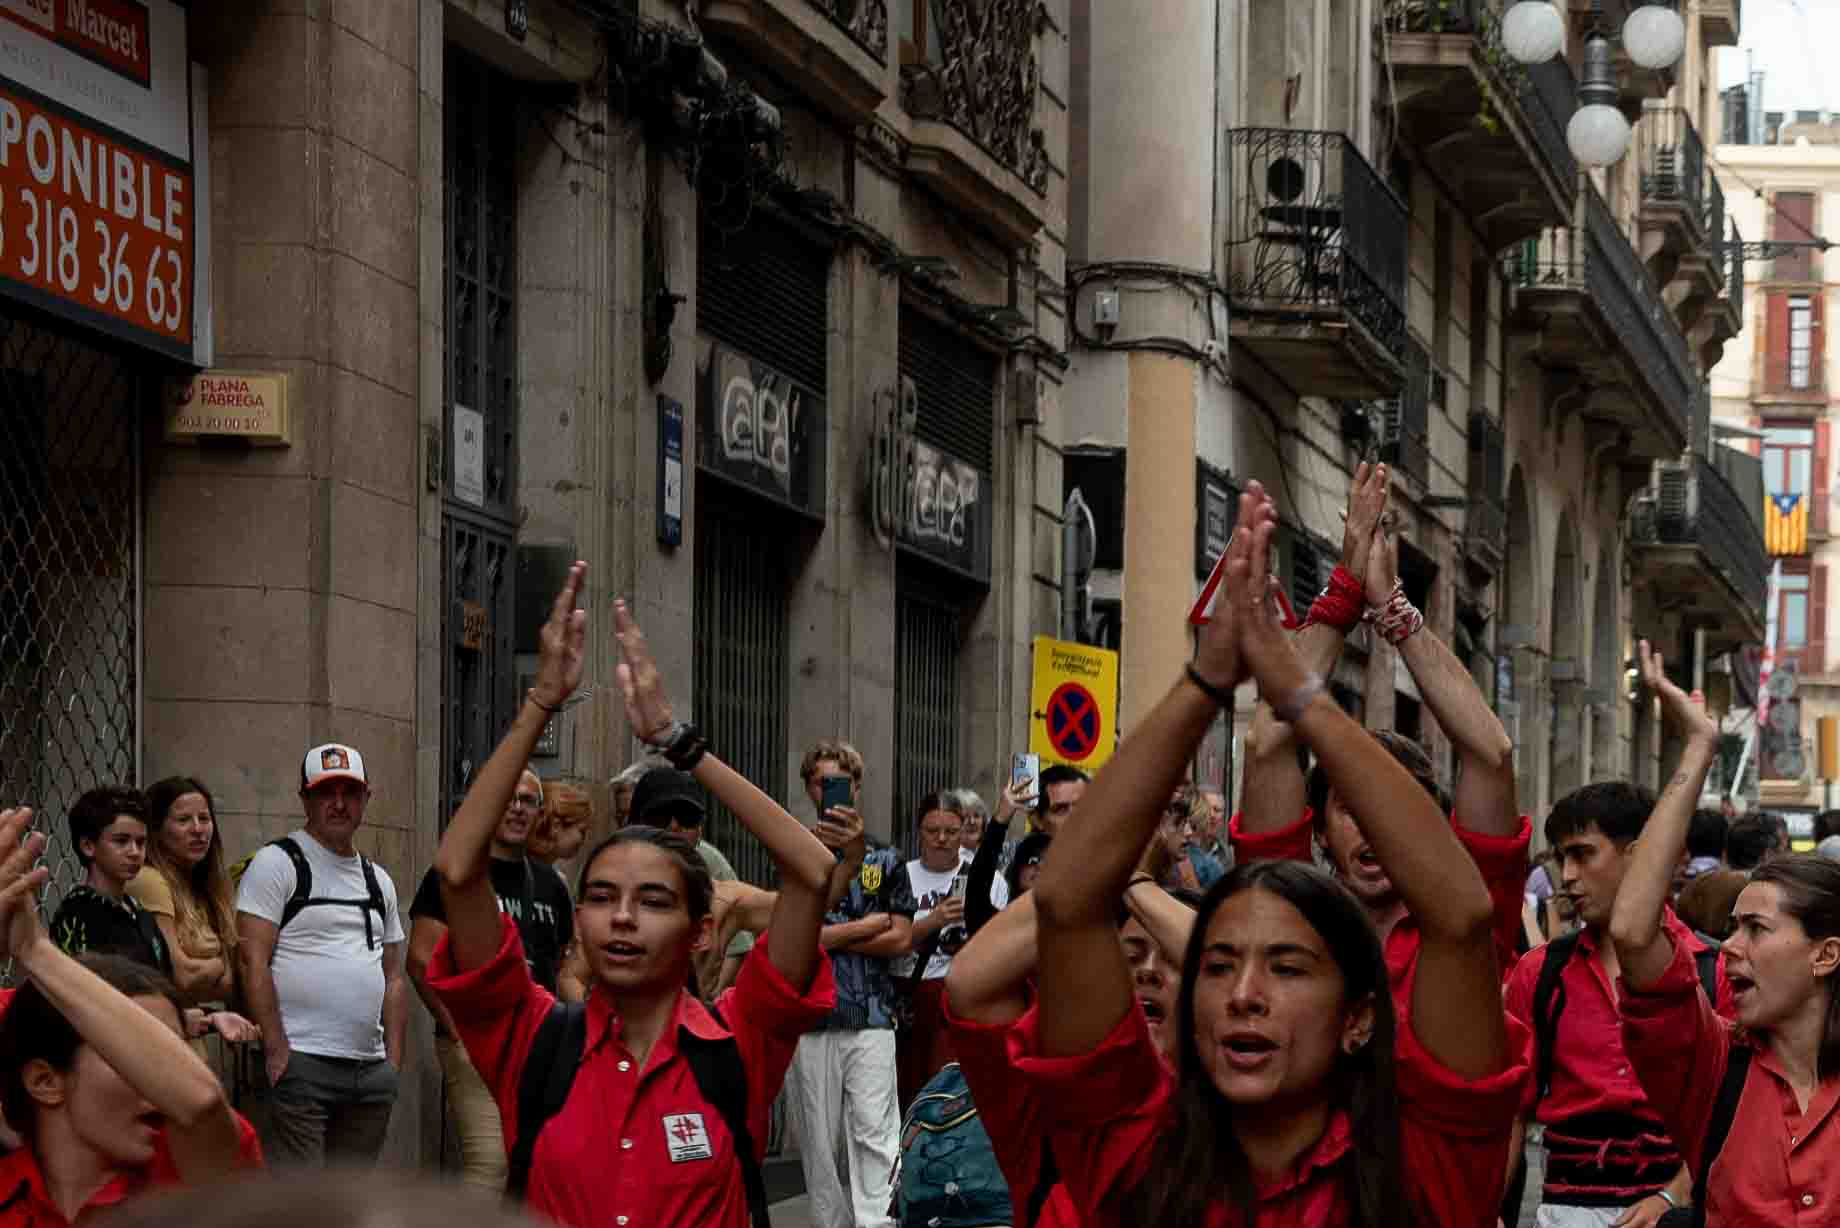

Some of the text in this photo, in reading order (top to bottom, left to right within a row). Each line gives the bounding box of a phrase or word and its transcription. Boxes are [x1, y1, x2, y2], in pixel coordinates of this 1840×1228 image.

[67, 0, 139, 61] Marcet
[21, 189, 182, 331] 318 36 63
[200, 379, 249, 393] PLANA
[200, 392, 264, 408] FABREGA
[224, 416, 240, 431] 00
